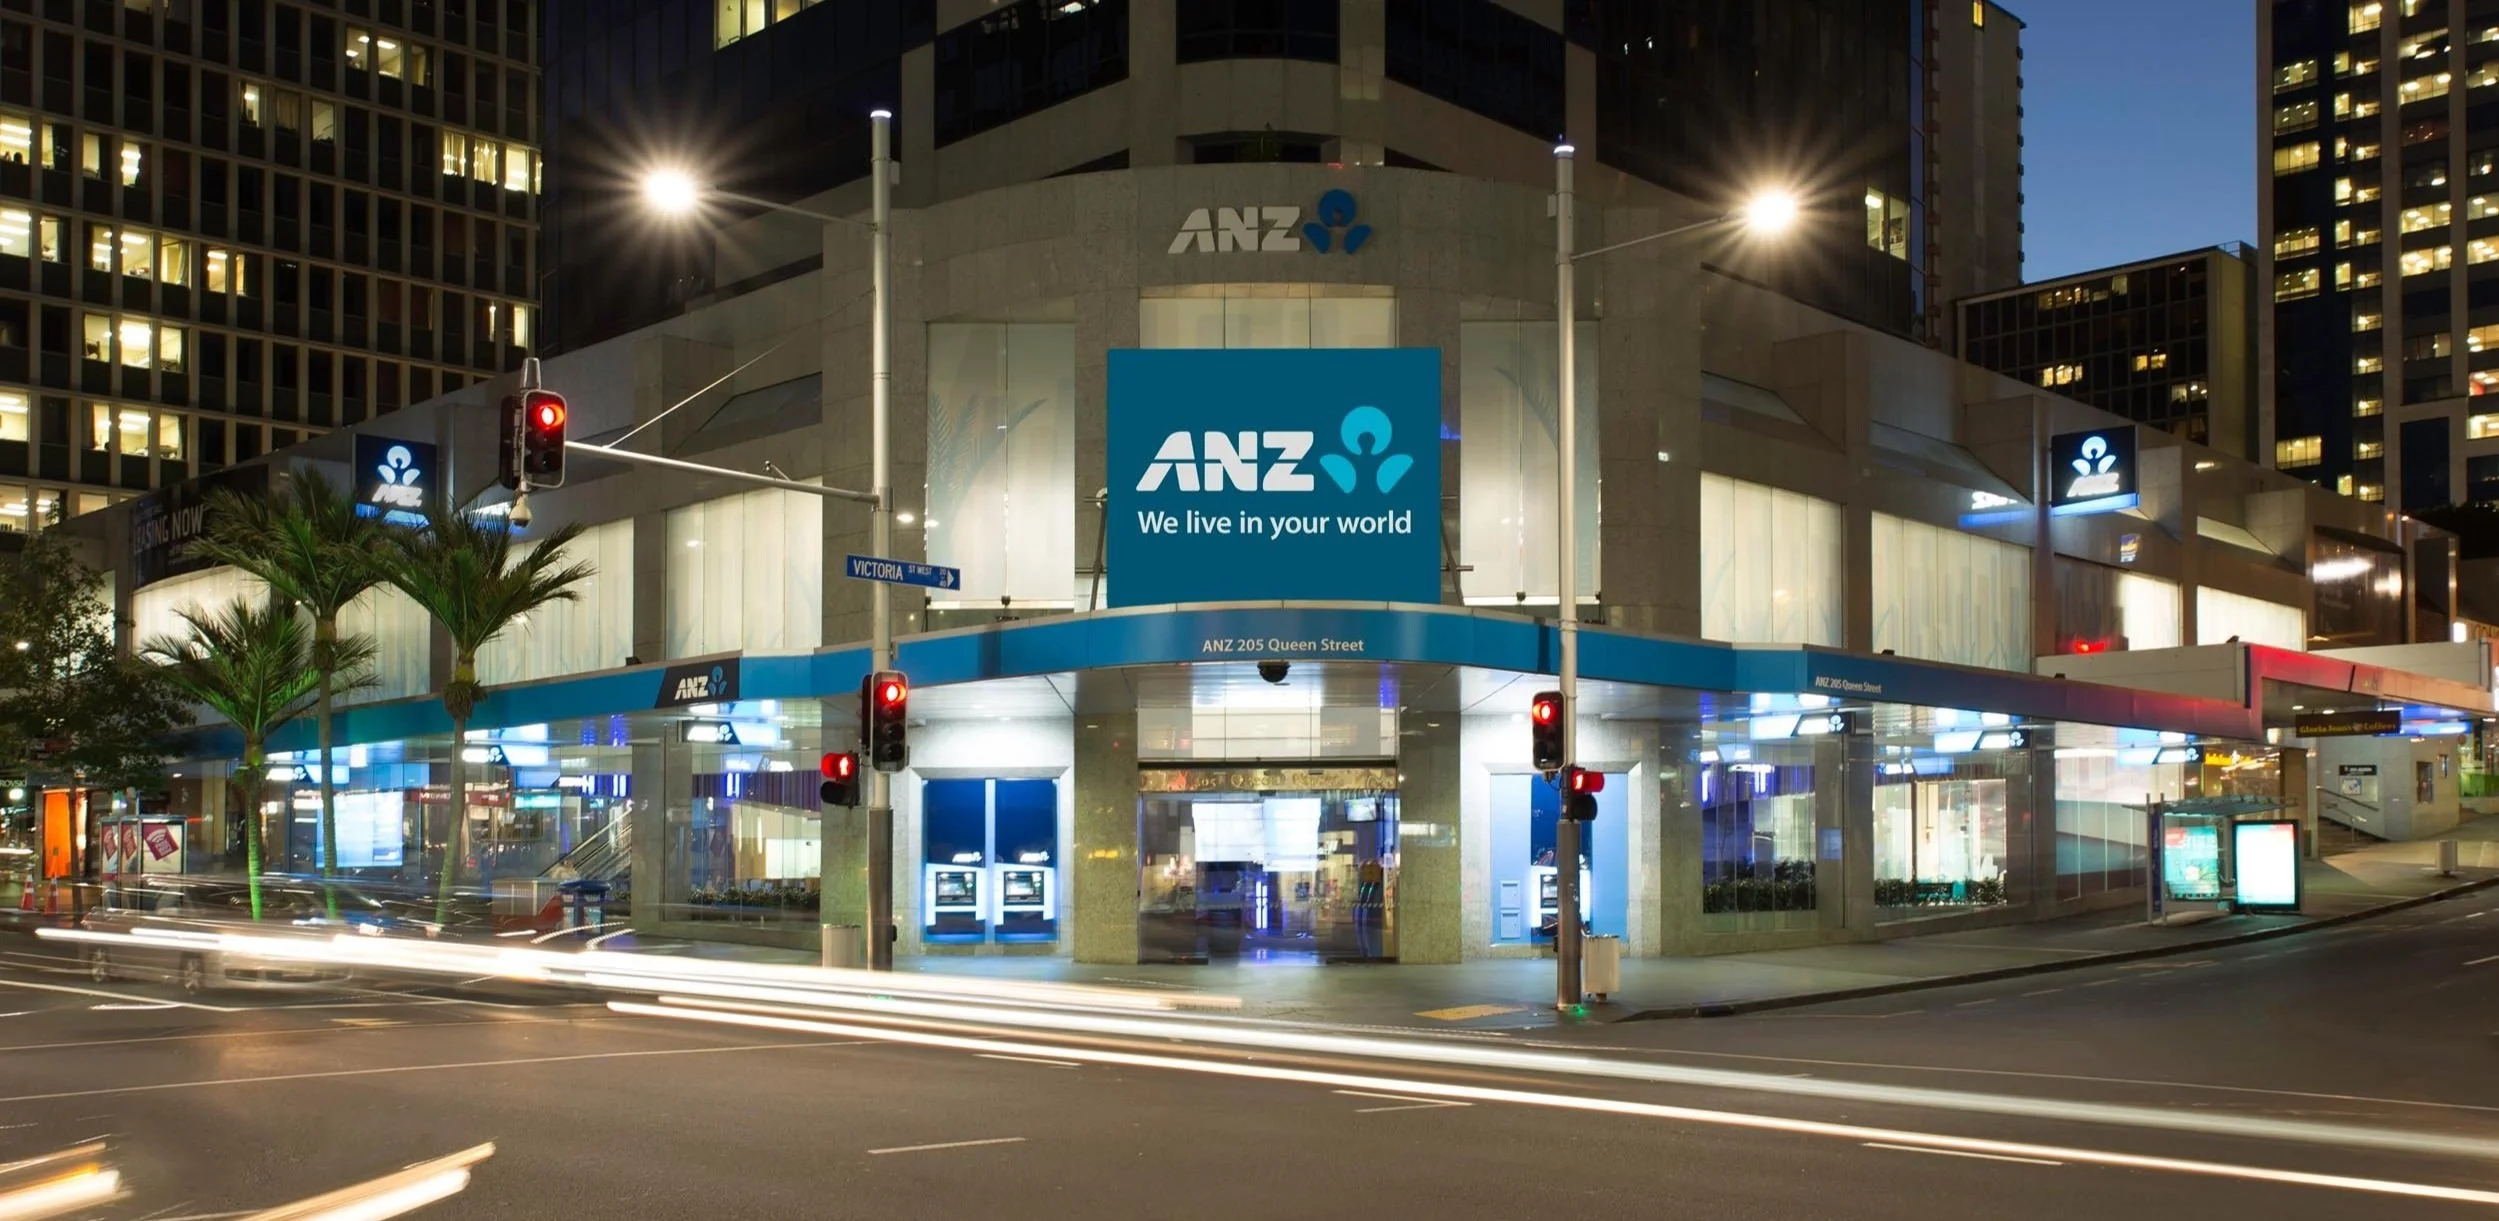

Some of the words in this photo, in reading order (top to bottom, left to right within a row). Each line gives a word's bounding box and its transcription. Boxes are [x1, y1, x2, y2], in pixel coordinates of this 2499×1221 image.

[1168, 206, 1301, 254] ANZ
[1136, 431, 1314, 491] ANZ
[133, 514, 169, 556] LEASING
[172, 504, 204, 540] NOW
[1138, 511, 1178, 534] We
[1187, 510, 1232, 534] live
[1240, 510, 1263, 534] in
[1270, 516, 1330, 541] your
[1337, 510, 1412, 534] world
[853, 559, 904, 581] VICTORIA
[908, 565, 917, 574] ST
[918, 566, 932, 576] WEST
[1202, 639, 1234, 653] ANZ
[1237, 639, 1264, 652] 205
[1268, 638, 1317, 653] Queen
[1321, 638, 1364, 652] Street
[675, 675, 709, 700] ANZ
[1815, 676, 1829, 688] ANZ
[1830, 678, 1842, 689] 205
[1843, 679, 1863, 692] Queen
[1863, 681, 1882, 694] Street
